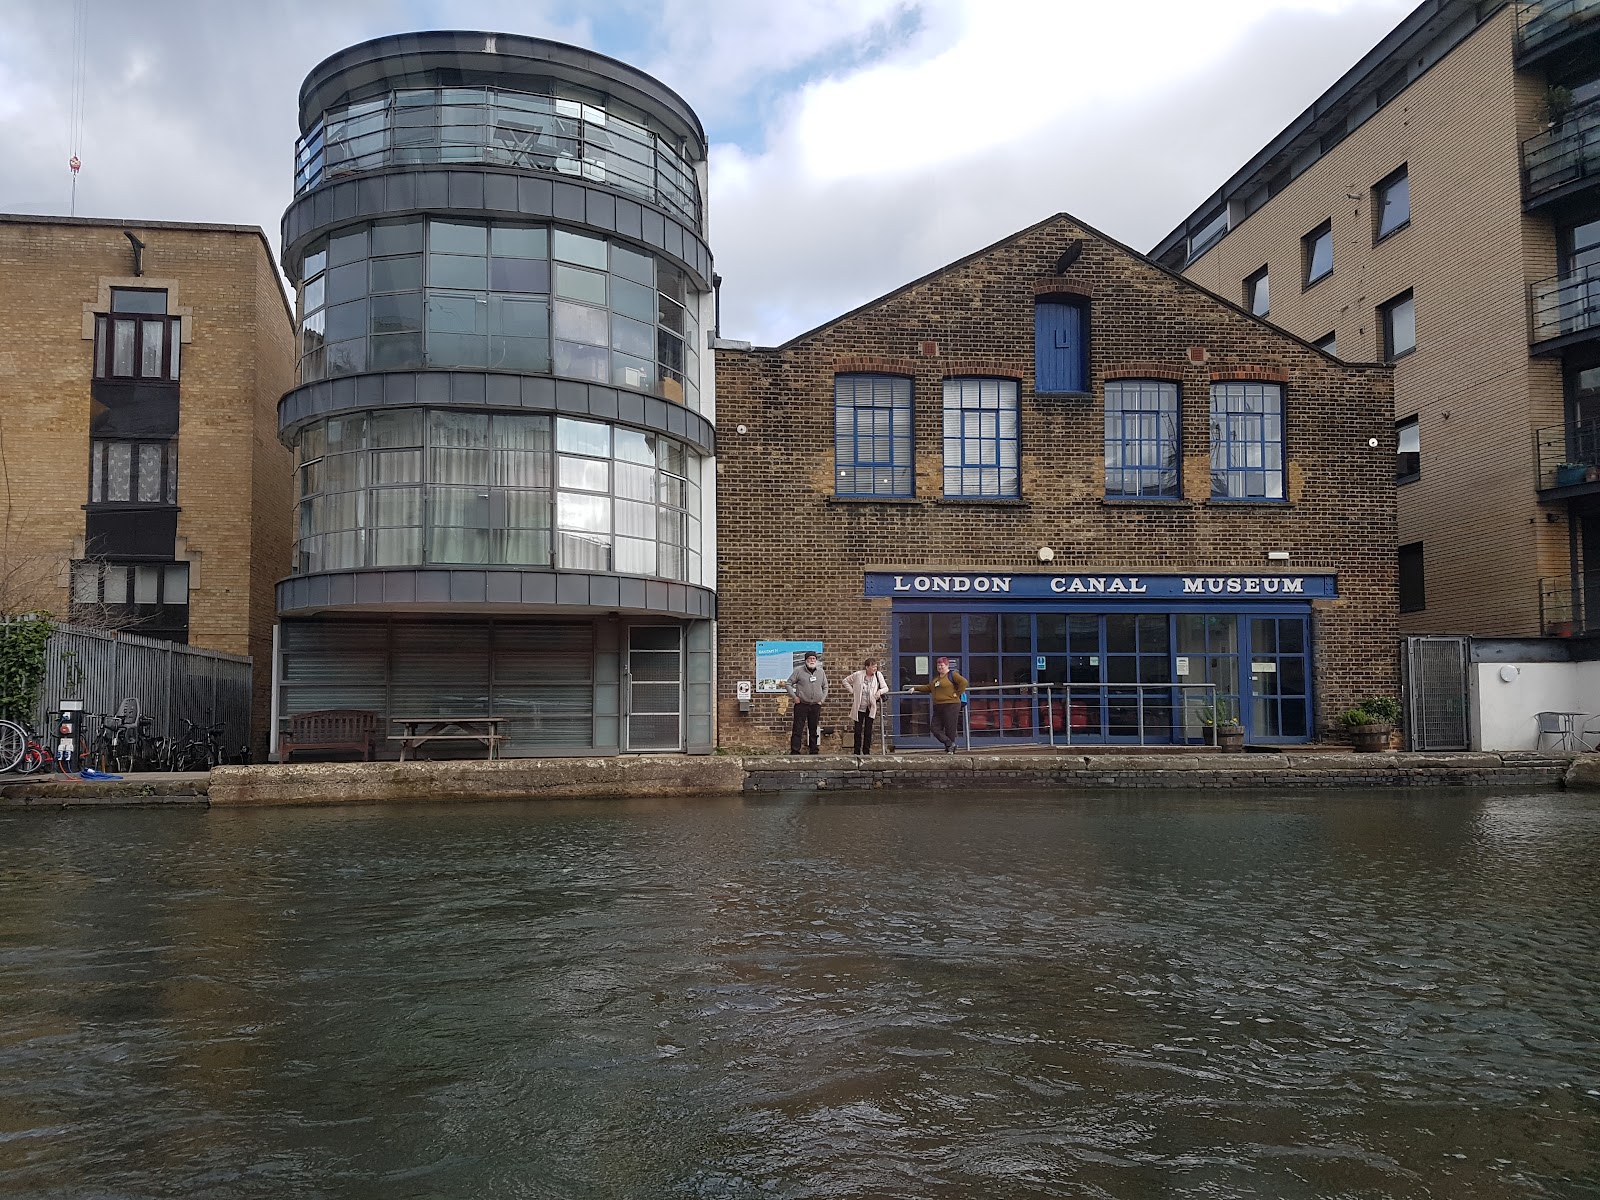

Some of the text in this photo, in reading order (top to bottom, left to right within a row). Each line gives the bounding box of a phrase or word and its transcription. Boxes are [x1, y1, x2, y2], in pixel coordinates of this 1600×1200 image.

[893, 576, 1304, 593] LONDON CANAL MUSEUM
